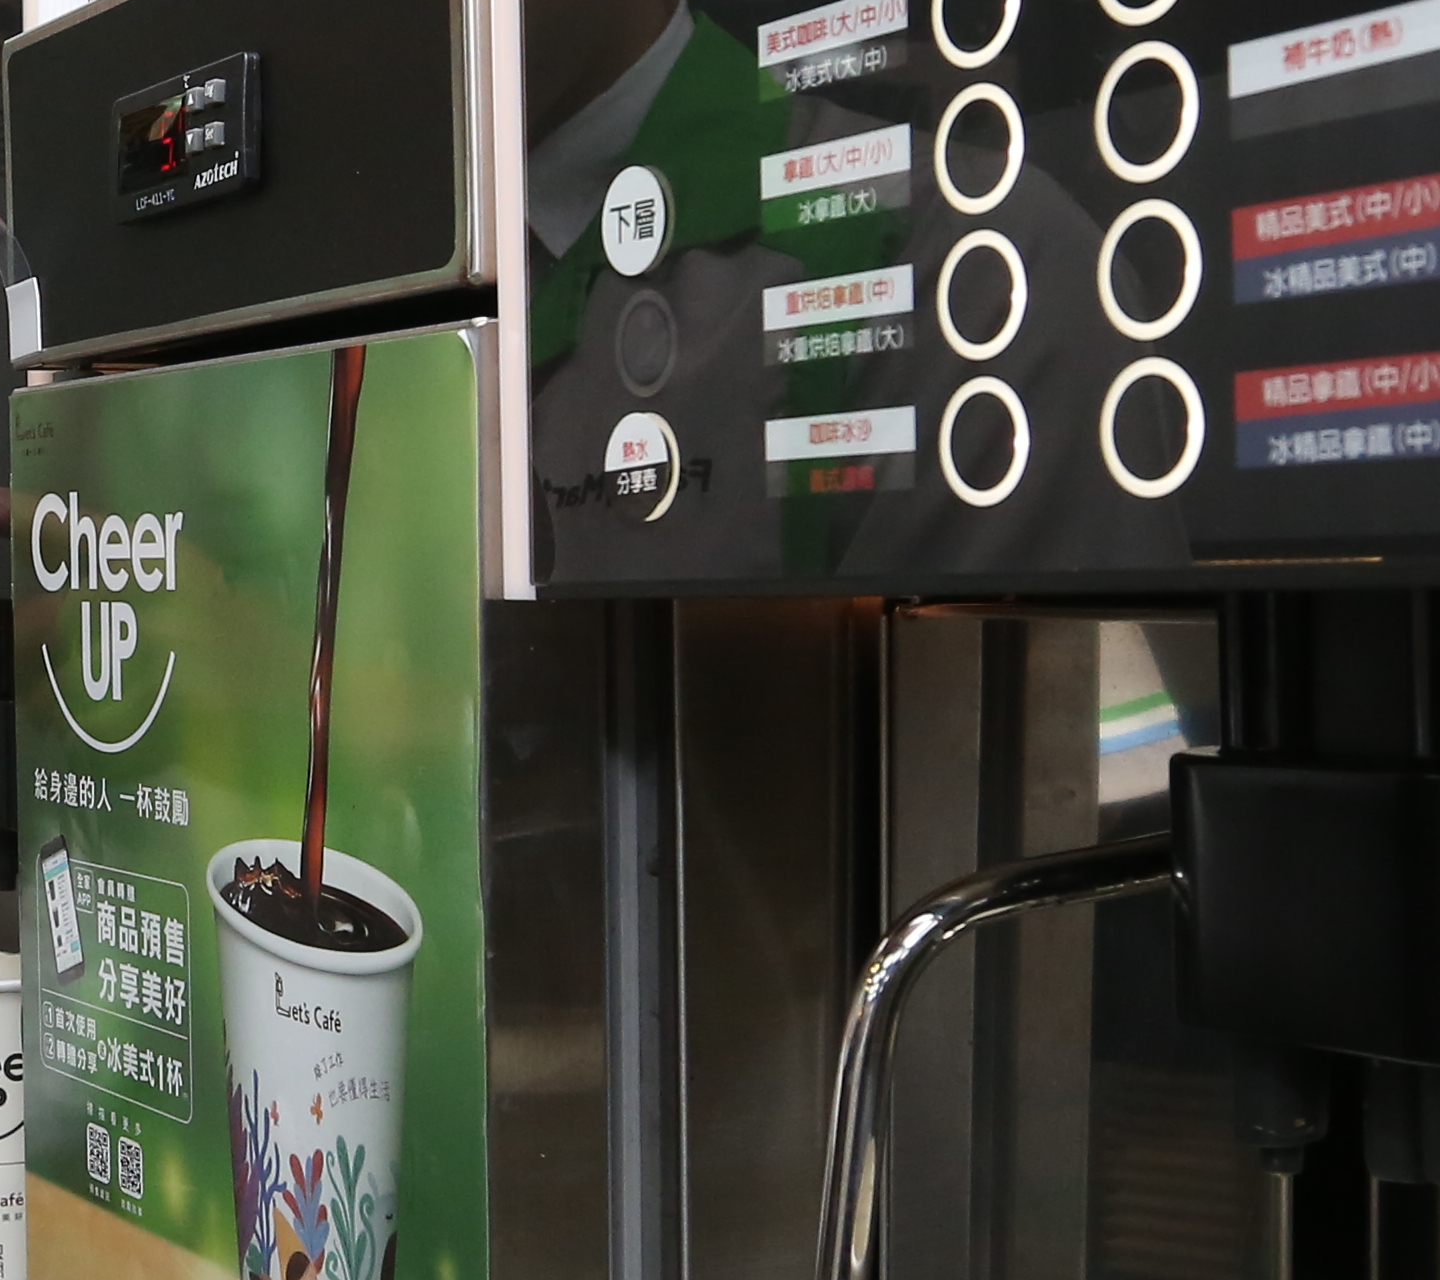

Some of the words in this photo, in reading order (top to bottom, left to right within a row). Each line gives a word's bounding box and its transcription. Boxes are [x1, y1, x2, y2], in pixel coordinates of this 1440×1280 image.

[610, 197, 656, 245] 下層
[617, 468, 658, 496] 分享壺
[31, 491, 184, 593] Cheer
[81, 601, 138, 702] UP
[34, 767, 112, 812] 給身邊的人
[119, 783, 190, 826] 一杯鼓勵
[96, 900, 186, 968] 商品預售
[98, 957, 187, 1026] 分享美好
[274, 971, 311, 1026] Let's
[313, 1005, 342, 1034] Café
